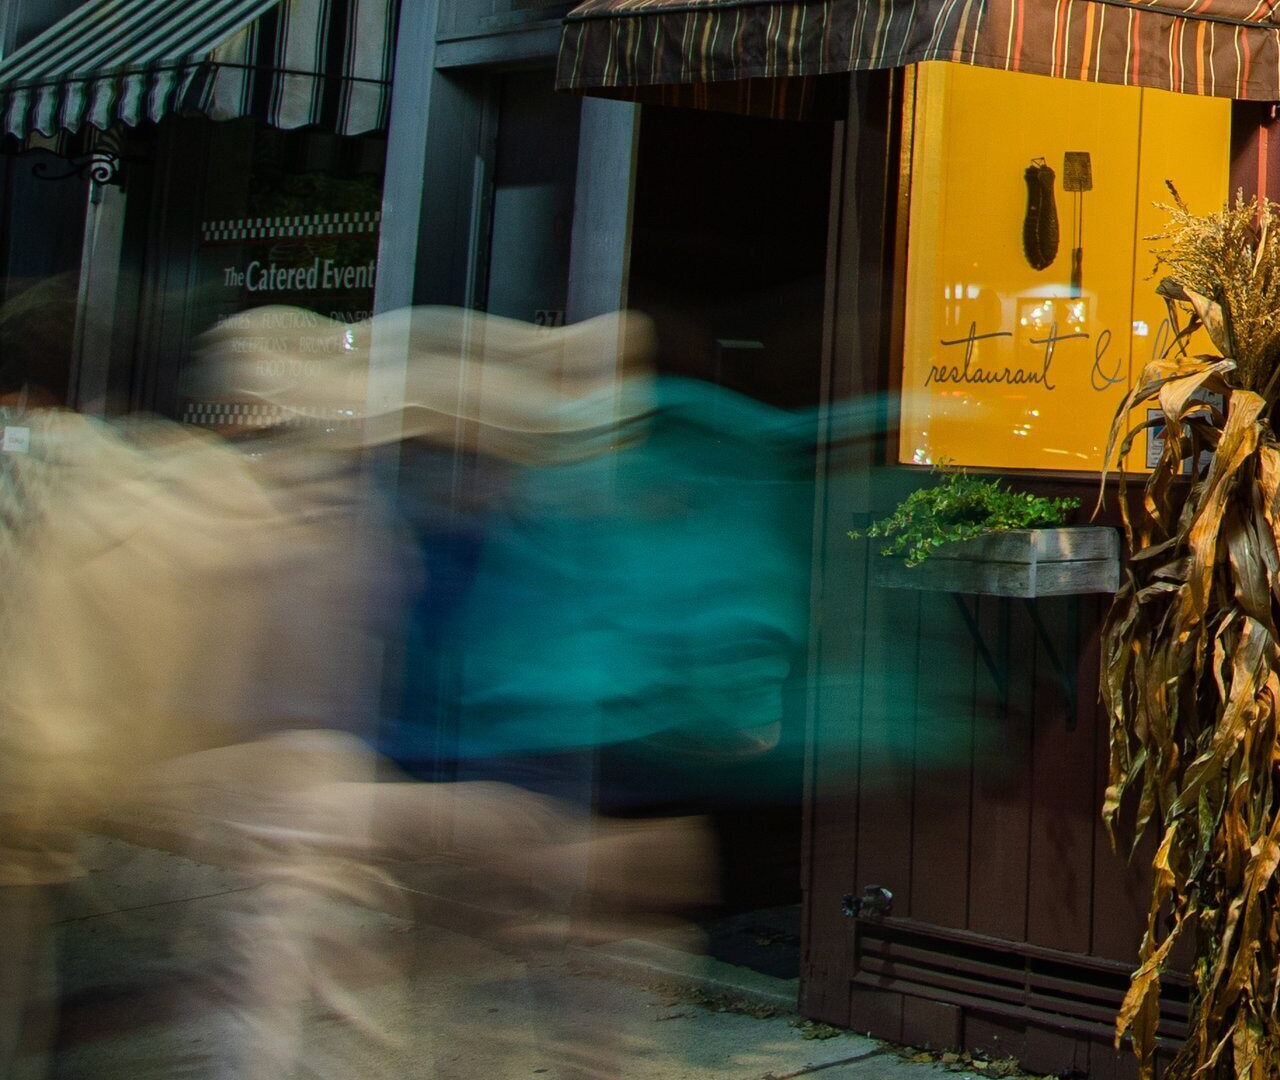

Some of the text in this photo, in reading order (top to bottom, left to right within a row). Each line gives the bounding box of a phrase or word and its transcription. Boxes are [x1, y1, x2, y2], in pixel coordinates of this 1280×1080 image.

[224, 257, 375, 292] The Catered Event
[924, 320, 1090, 391] restaurant
[1091, 329, 1127, 392] &
